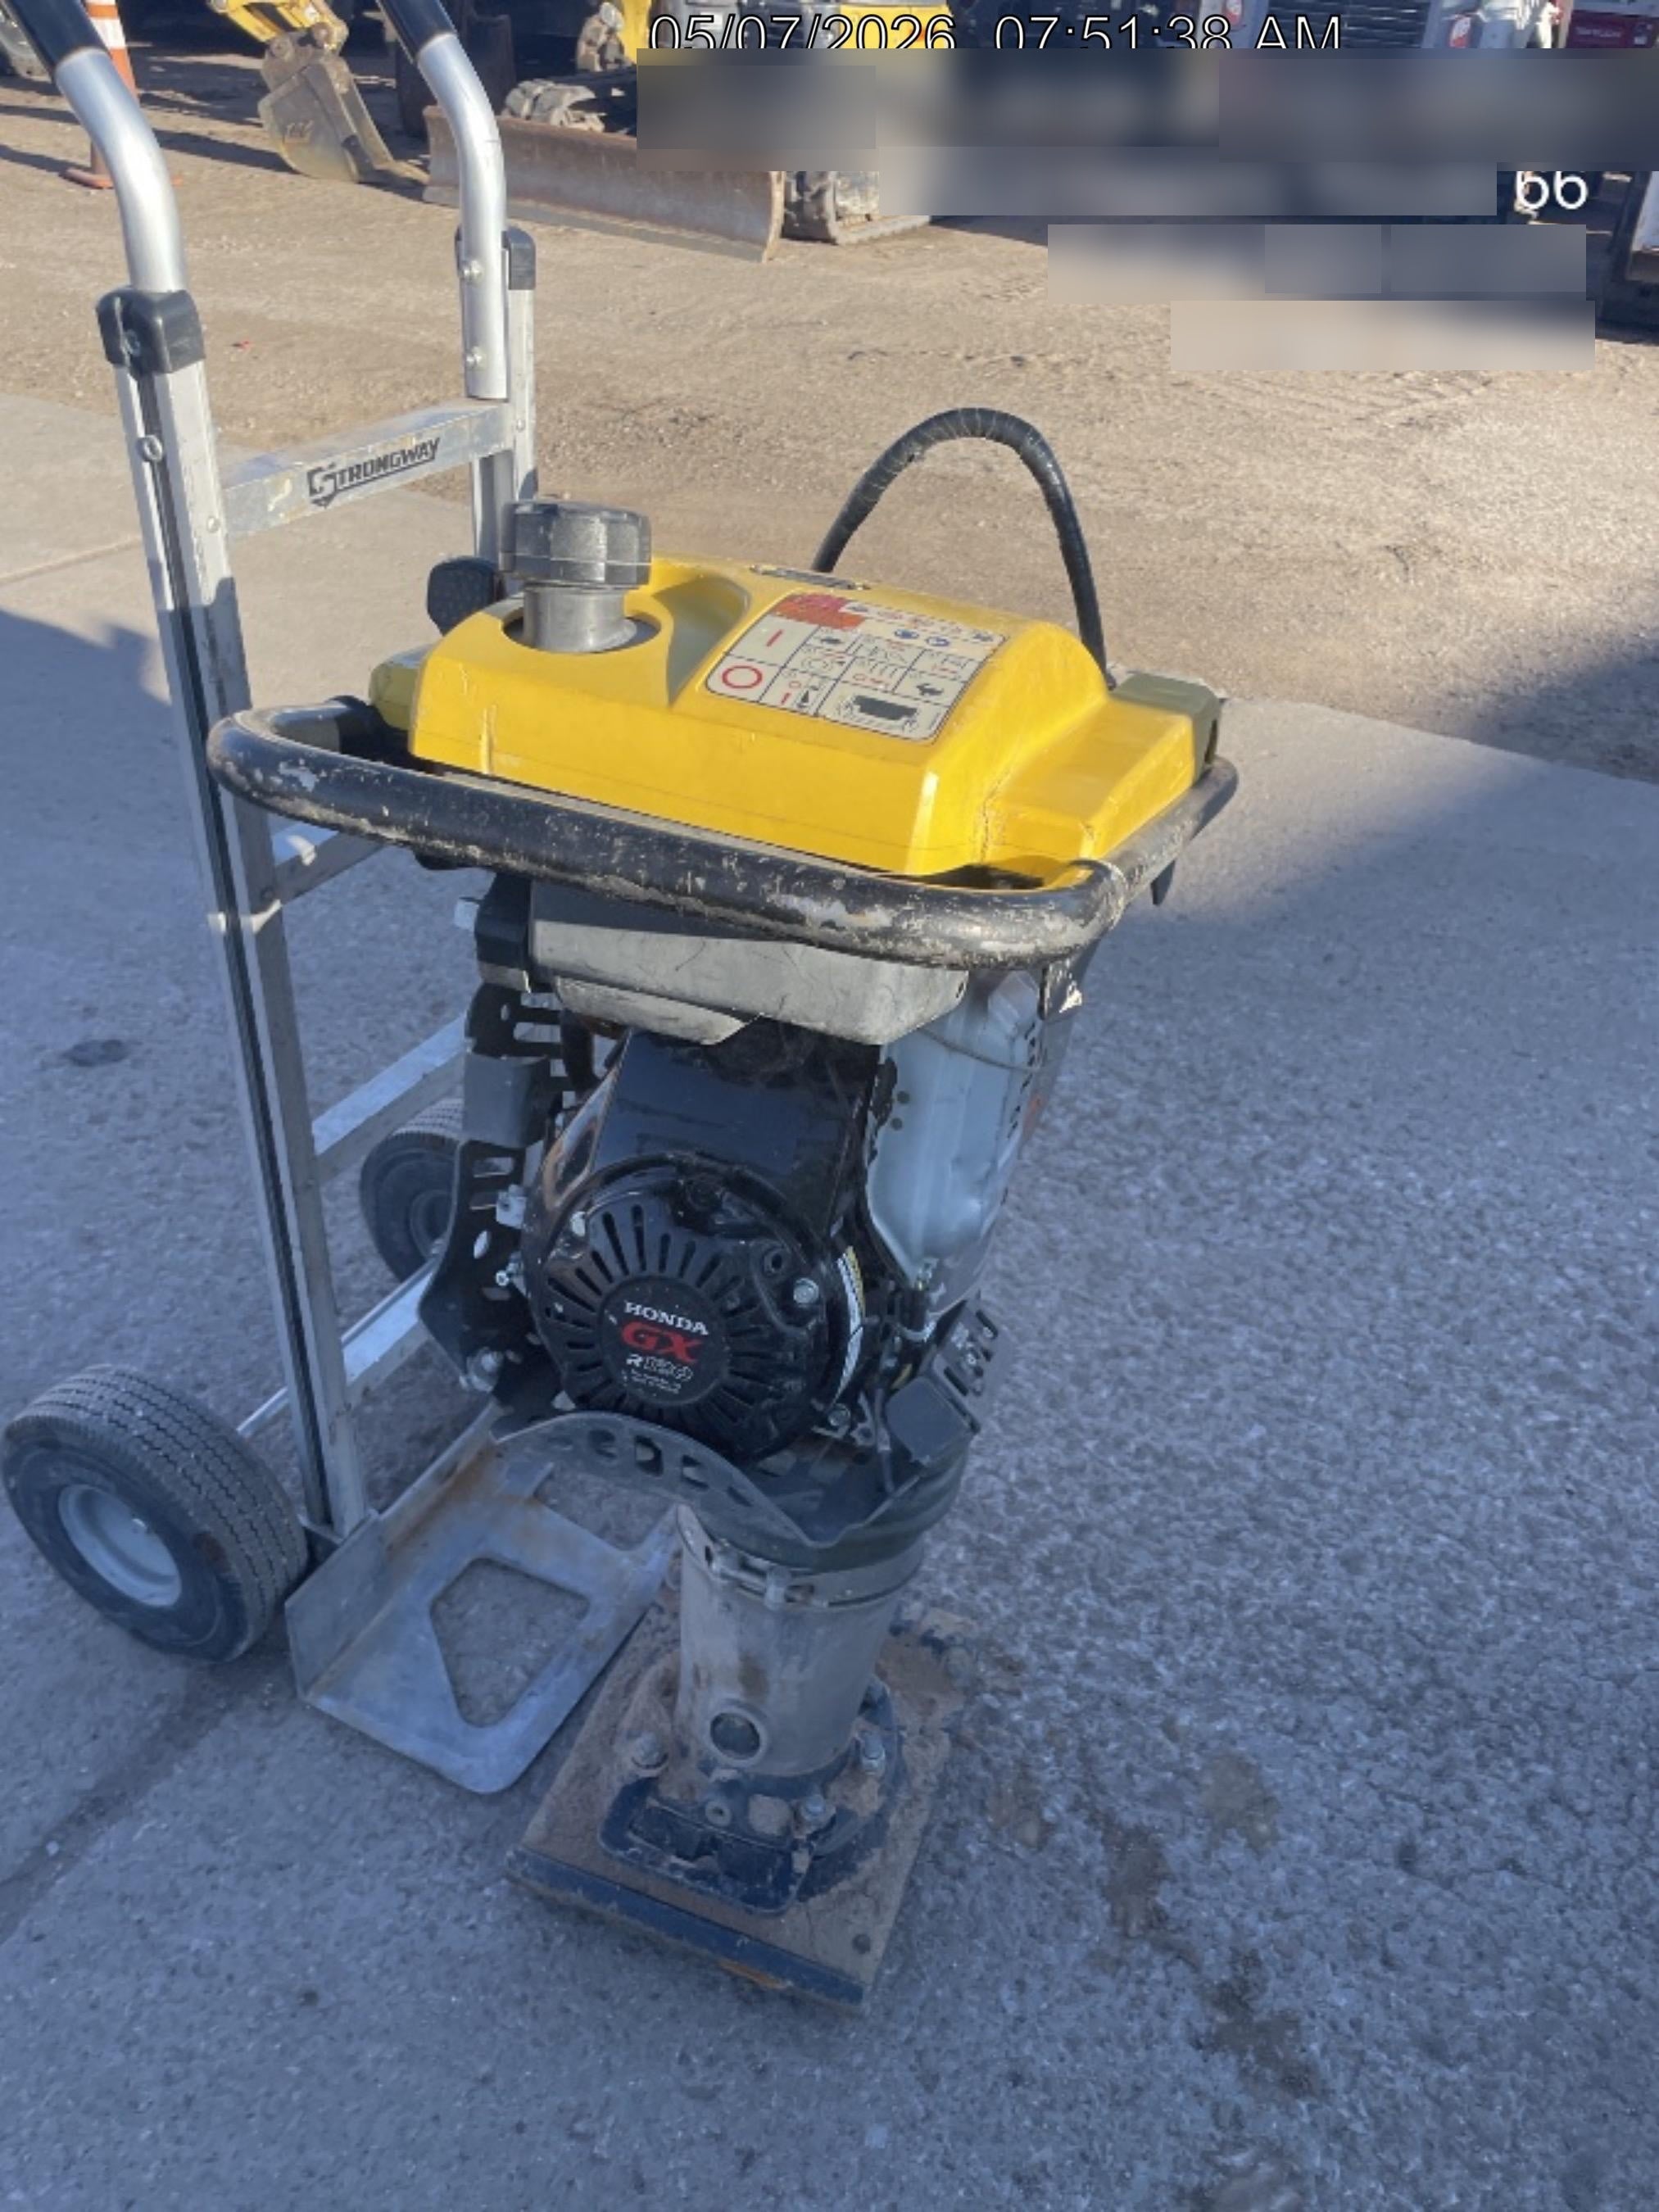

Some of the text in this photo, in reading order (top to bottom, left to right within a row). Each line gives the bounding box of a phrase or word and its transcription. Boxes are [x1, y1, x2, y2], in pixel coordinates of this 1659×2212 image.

[307, 437, 440, 510] STRONGWAY
[624, 1302, 709, 1335] HONDA
[622, 1321, 703, 1362] GX
